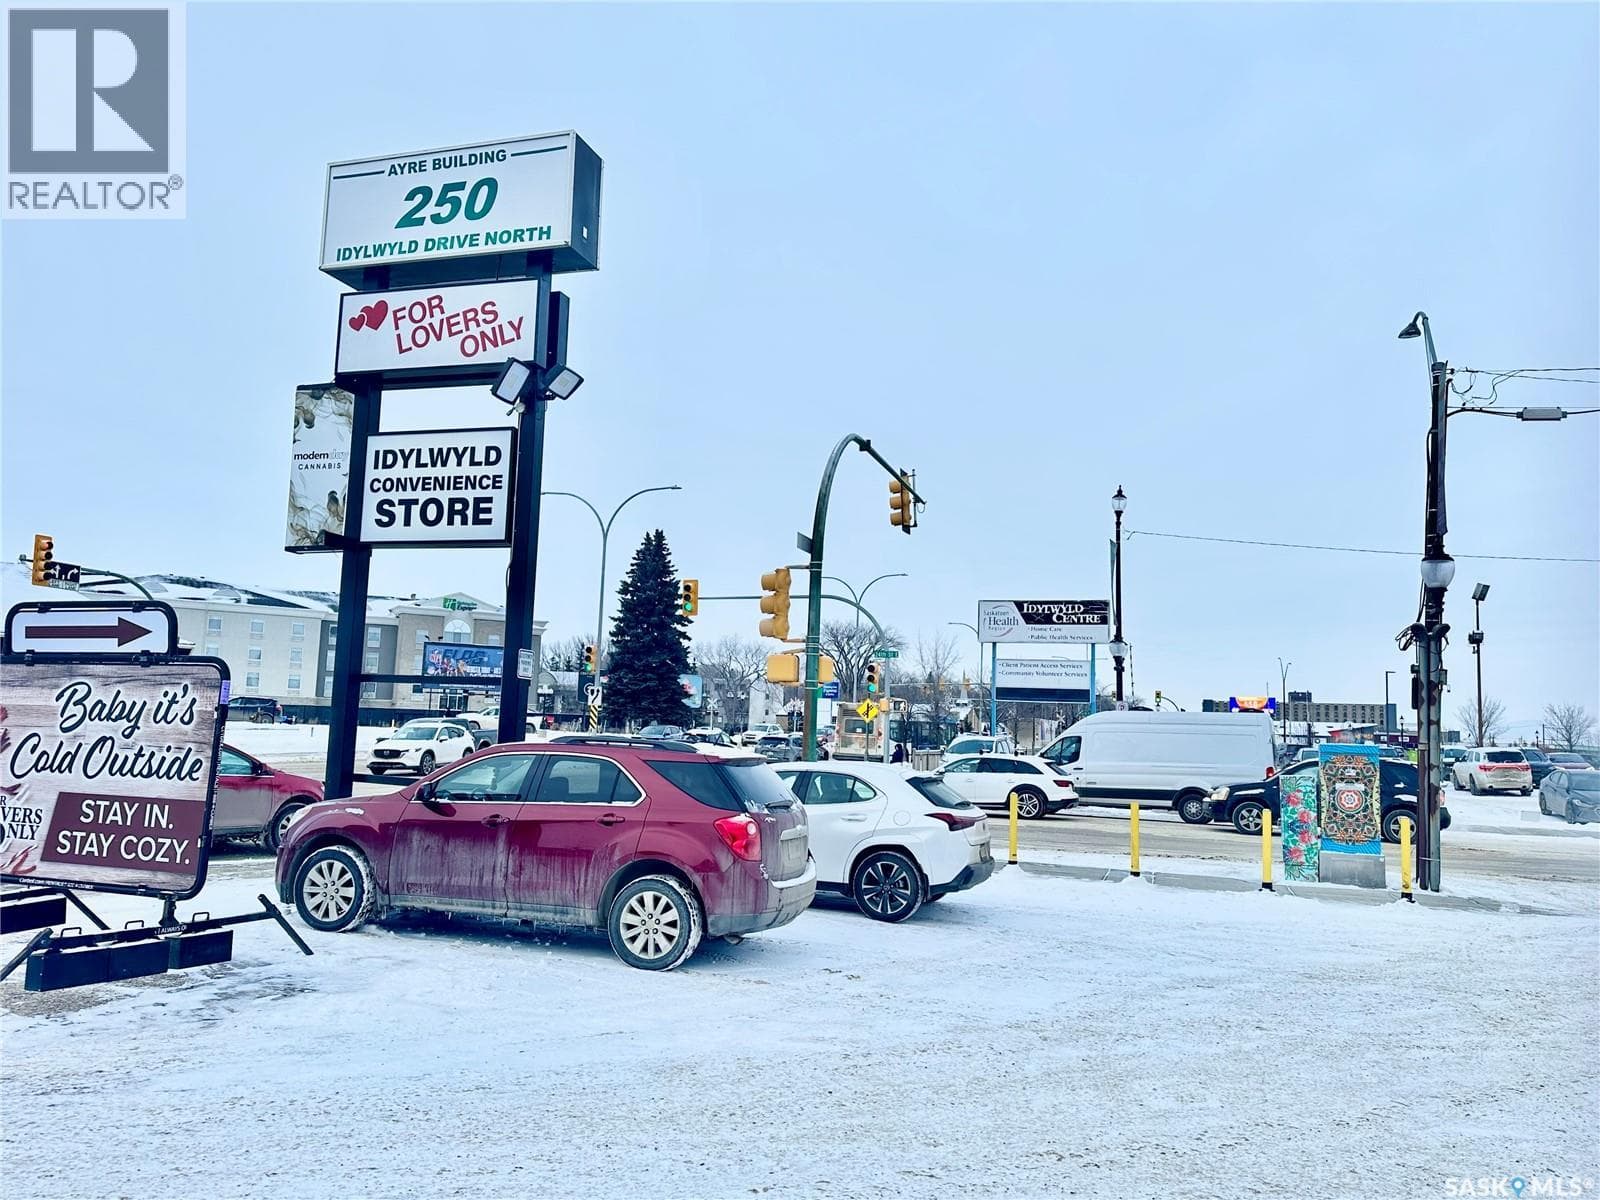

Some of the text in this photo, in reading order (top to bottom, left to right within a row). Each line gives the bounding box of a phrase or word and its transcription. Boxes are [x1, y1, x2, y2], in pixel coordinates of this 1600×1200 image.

[387, 149, 507, 177] AYRE BUILDING
[394, 177, 499, 229] 250
[336, 225, 551, 262] IDYLWYLD DRIVE NORTH
[392, 294, 445, 331] FOR
[396, 300, 499, 355] LOVERS
[460, 315, 525, 358] ONLY
[298, 462, 342, 471] CANNABIS
[373, 445, 502, 470] IDYLWYLD
[369, 474, 503, 493] CONVENIENCE
[374, 496, 494, 528] STORE
[988, 616, 1019, 626] Health
[1023, 603, 1084, 614] IDYLWYLD
[1052, 613, 1101, 624] CENTRE
[55, 680, 197, 740] Baby it's
[10, 732, 82, 781] Cold
[82, 735, 204, 782] Outside
[79, 799, 140, 827] STAY
[143, 802, 174, 831] IN.
[56, 830, 191, 866] STAY COZY.
